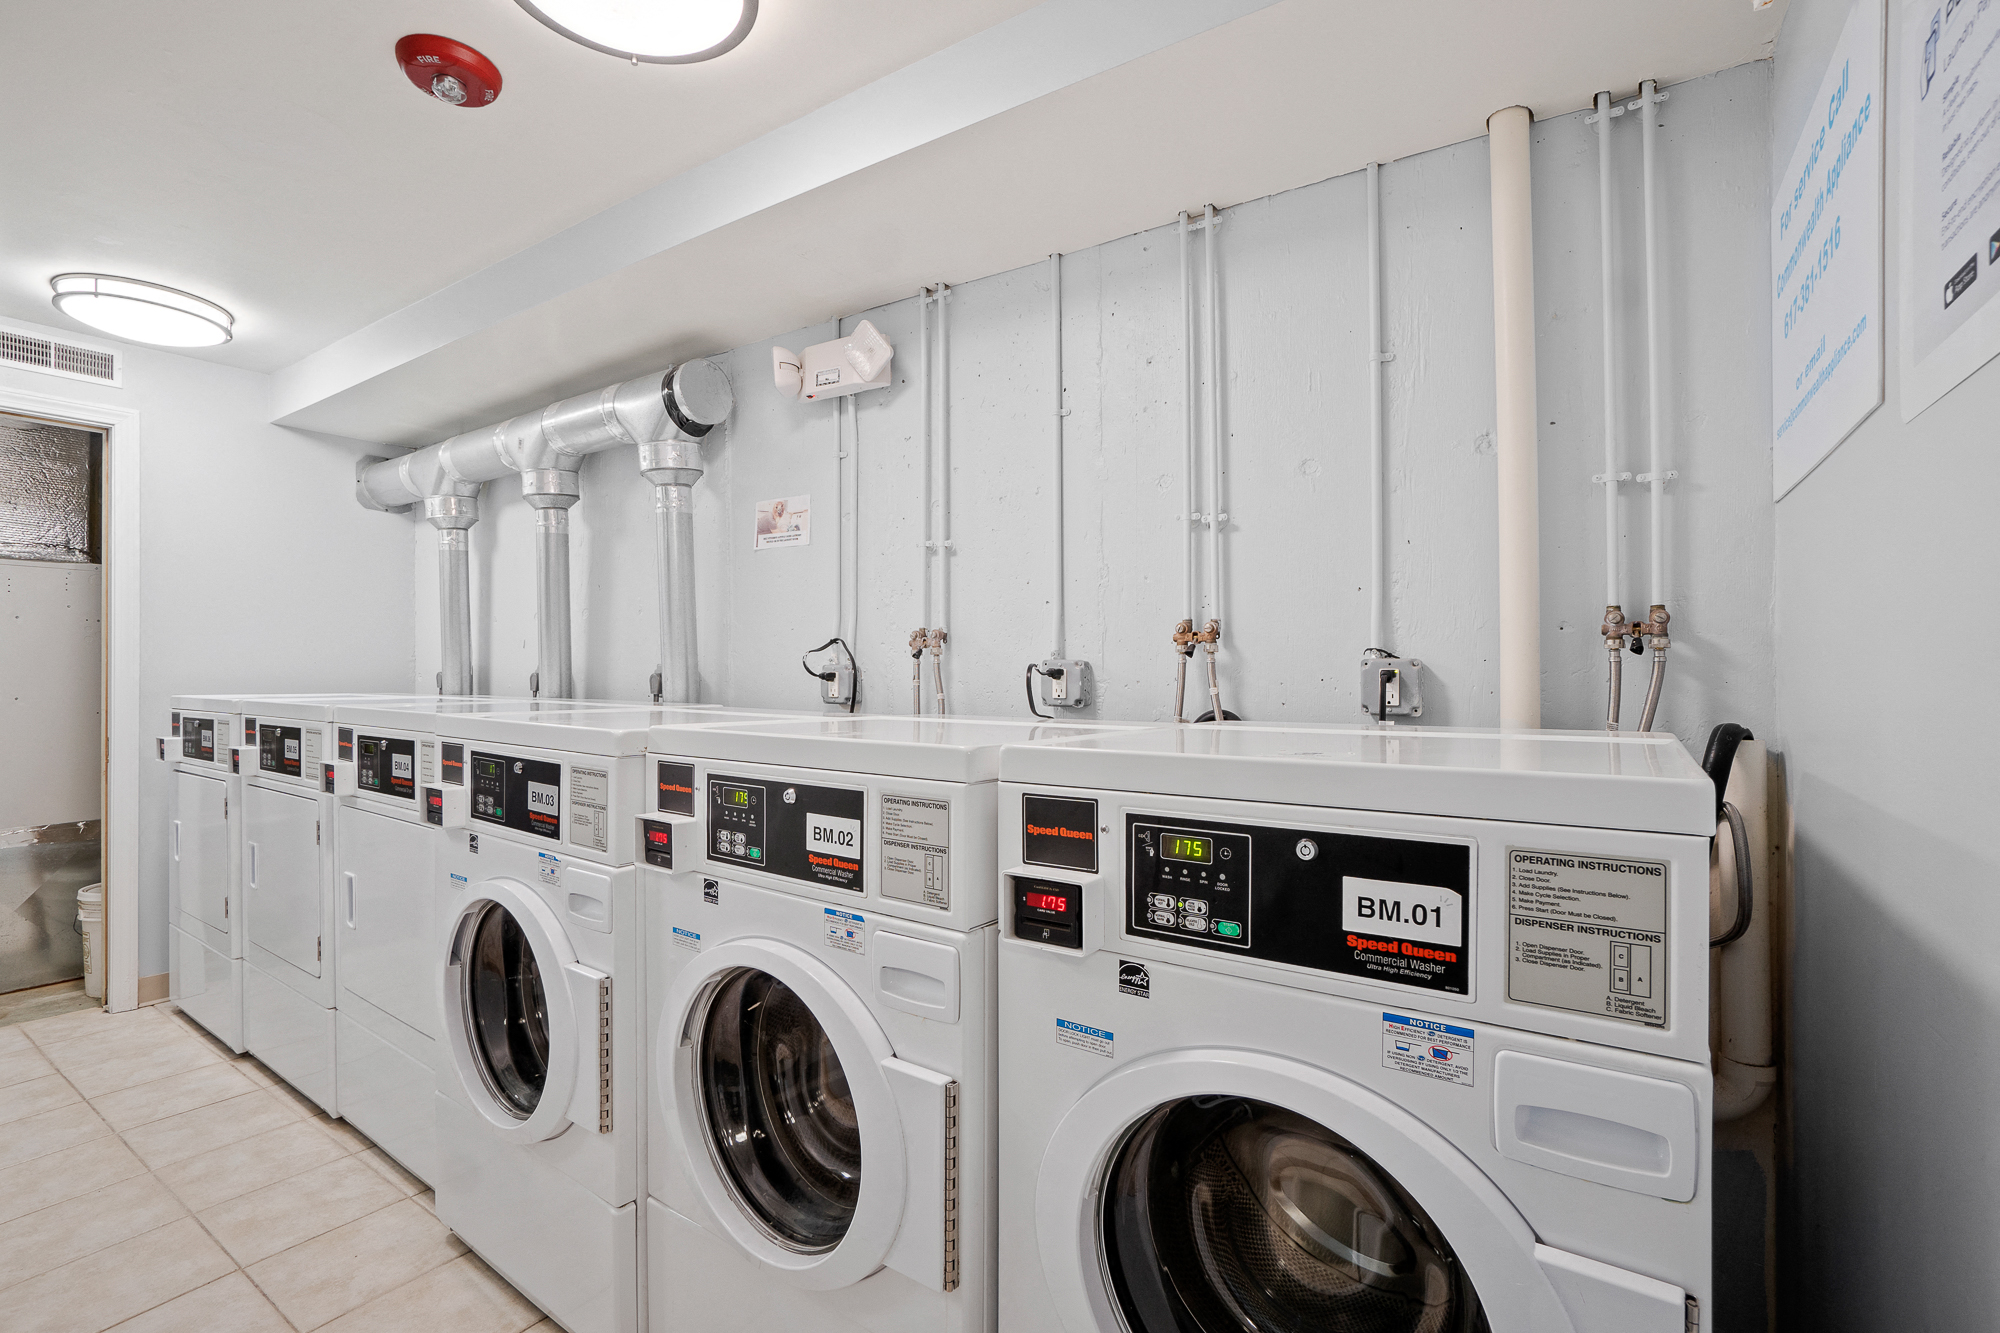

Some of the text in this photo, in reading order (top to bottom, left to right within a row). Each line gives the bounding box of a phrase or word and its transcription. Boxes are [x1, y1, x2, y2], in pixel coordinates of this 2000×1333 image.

[416, 54, 441, 64] FIRE
[1780, 57, 1849, 241] For service Call
[1776, 92, 1871, 299] Commonwealth Appliance
[1784, 214, 1841, 339] 617-361-1516
[1795, 333, 1826, 391] or email
[394, 760, 410, 772] BM.04
[660, 782, 692, 794] Speed Queen
[531, 790, 555, 807] BM.03
[883, 797, 948, 811] OPERATING INSTRUCTIONS
[529, 811, 558, 825] Speed Queen
[813, 825, 854, 848] BM.02
[1026, 823, 1093, 840] Speed Queen
[883, 839, 948, 855] DISPENSER INSTRUCTIONS
[1175, 839, 1203, 857] 175
[808, 853, 859, 871] Speed Queen
[1514, 854, 1662, 877] OPERATING INSTRUCTIONS
[811, 864, 854, 879] Commercial Washer
[1534, 868, 1559, 877] Laundry.
[1531, 883, 1556, 892] Supplies
[1557, 886, 1571, 894] (See
[1572, 888, 1607, 897] Instructions
[1607, 891, 1631, 901] Below).
[1535, 891, 1552, 899] Cycle
[1552, 893, 1581, 902] Selection.
[1535, 898, 1561, 907] Payment.
[1357, 895, 1441, 928] BM.01
[1518, 904, 1535, 912] Press
[1535, 906, 1549, 914] Start
[1550, 908, 1566, 916] (Door
[1567, 910, 1583, 918] Must
[1592, 913, 1618, 922] Closed).
[676, 928, 697, 939] NOTICE
[1514, 917, 1662, 943] DISPENSER INSTRUCTIONS
[1346, 934, 1457, 963] Speed Queen
[1522, 941, 1538, 949] Open
[1539, 943, 1568, 953] Dispenser
[1353, 950, 1446, 974] Commercial Washer
[1522, 953, 1560, 963] Compartment
[1561, 957, 1571, 965] (as
[1537, 949, 1562, 958] Supplies
[1570, 953, 1590, 961] Proper
[1366, 963, 1433, 980] Ultra High Efficiency
[1522, 957, 1539, 965] Close
[1539, 960, 1569, 969] Dispenser
[1569, 964, 1585, 972] Door.
[1119, 986, 1149, 998] ENERGY STAR
[1614, 996, 1645, 1006] Detergent
[1614, 1002, 1632, 1010] Liquid
[1634, 1005, 1656, 1013] Bleach
[1614, 1008, 1634, 1016] Fabric
[1635, 1011, 1662, 1020] Softener
[1064, 1021, 1106, 1039] NOTICE
[1409, 1018, 1447, 1032] NOTICE
[1385, 1028, 1417, 1039] RECOMMENDED
[1438, 1039, 1471, 1050] PERFORMANCE
[1437, 1034, 1462, 1043] DETERGENT
[1394, 1060, 1420, 1070] DETERGENT
[1399, 1066, 1434, 1077] RECOMMENDED
